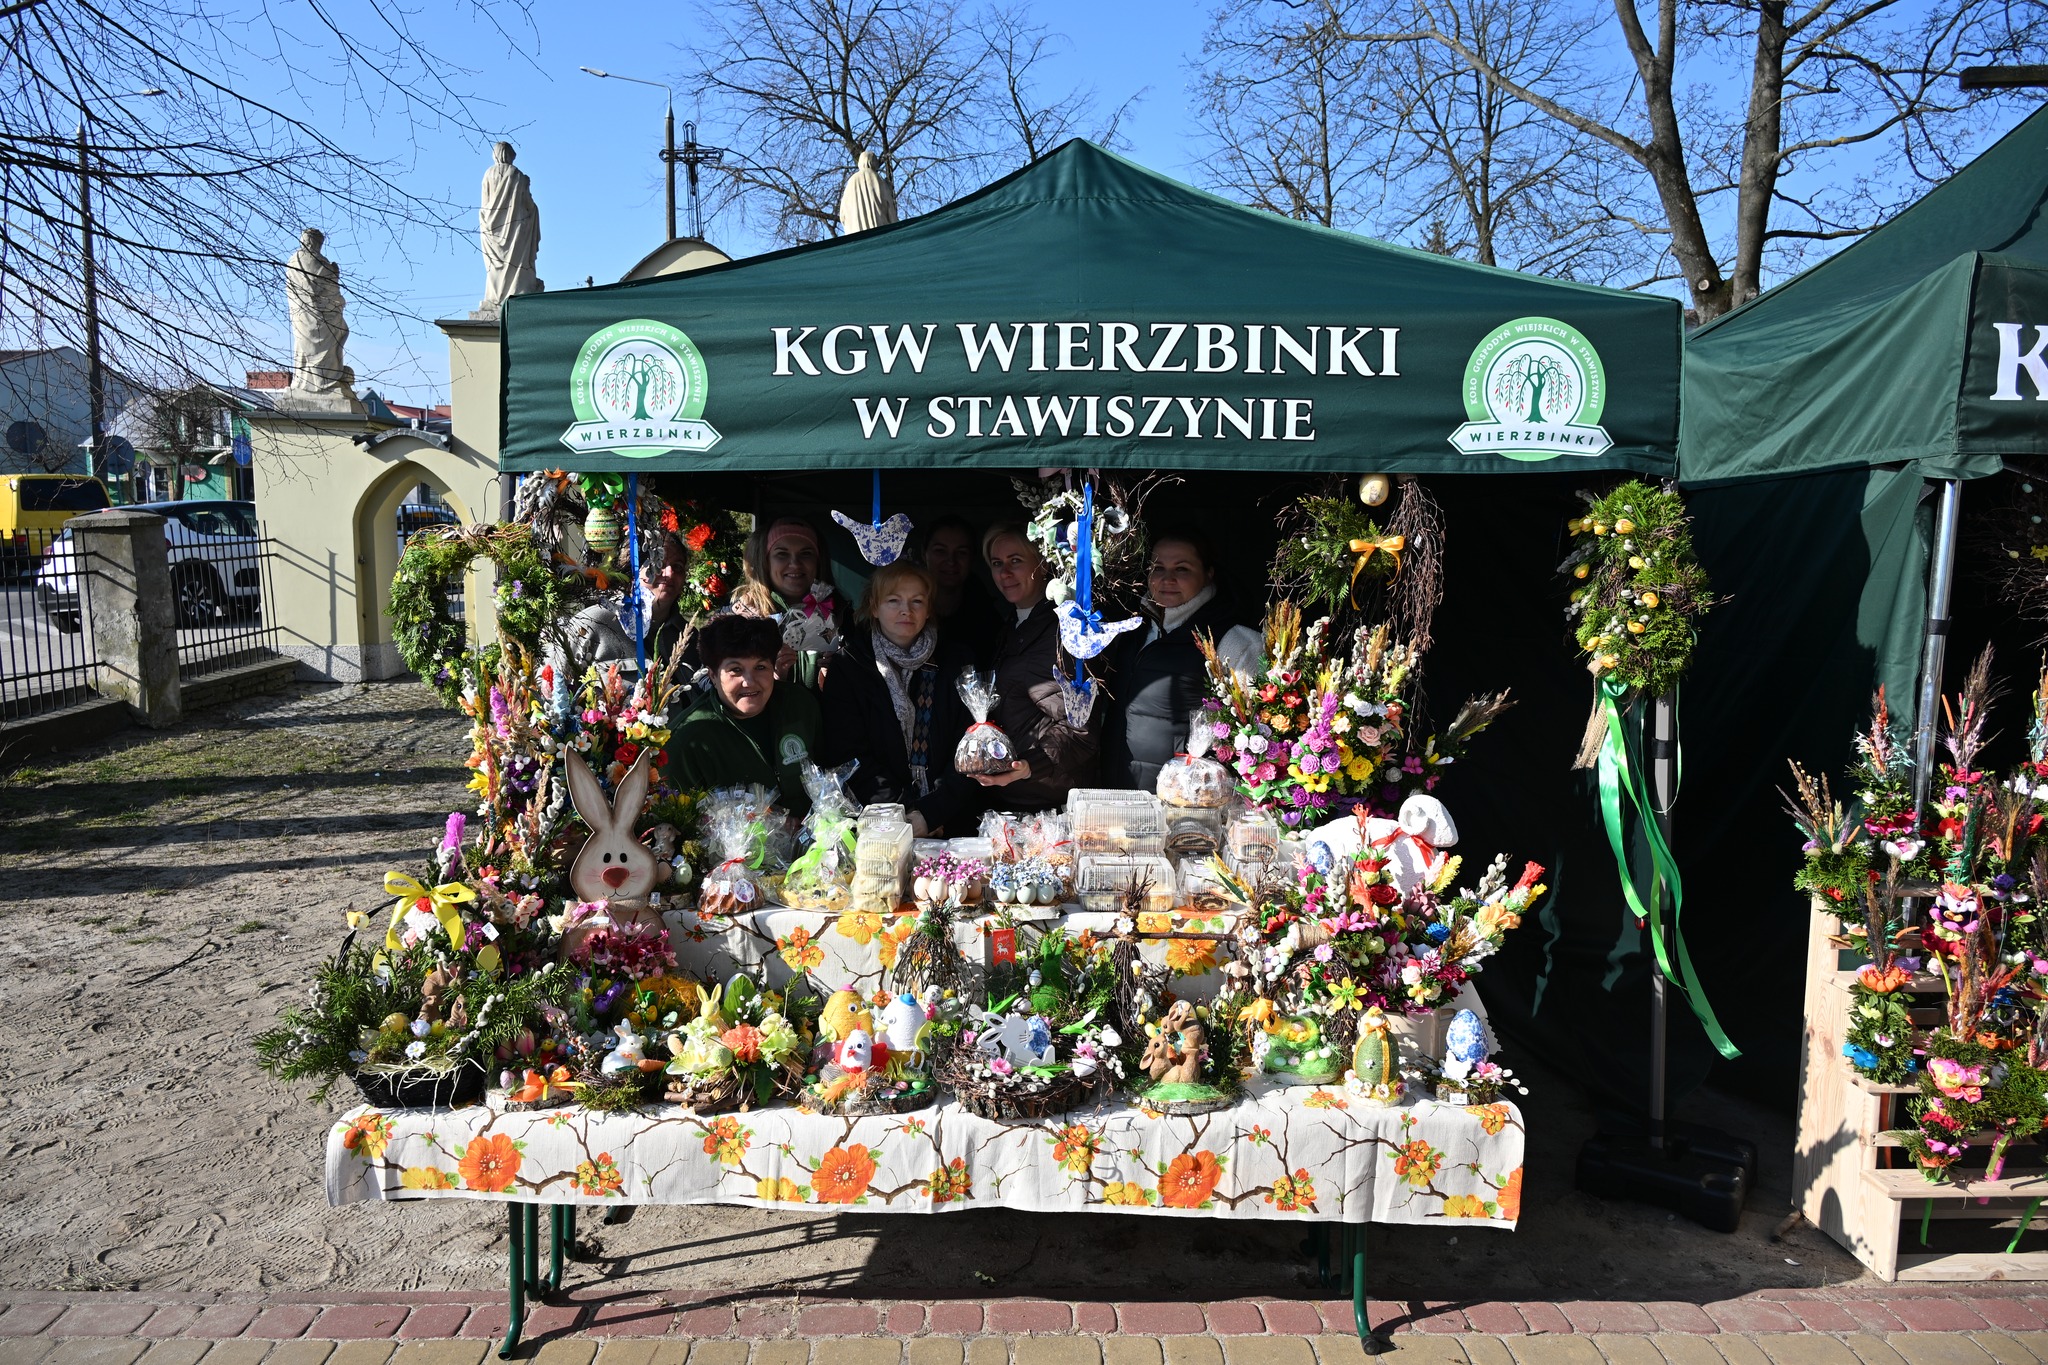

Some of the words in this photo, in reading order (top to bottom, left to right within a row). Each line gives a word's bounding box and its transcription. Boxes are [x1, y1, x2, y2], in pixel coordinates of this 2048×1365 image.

[576, 378, 586, 406] KOŁO
[617, 325, 668, 337] WIEJSKICH
[670, 333, 680, 343] W
[679, 343, 702, 403] STAWISZYNIE
[771, 325, 938, 376] KGW
[956, 323, 1400, 377] WIERZBINKI
[1469, 377, 1478, 405] KOŁO
[1514, 323, 1568, 339] WIEJSKICH
[1569, 335, 1580, 346] W
[1578, 346, 1600, 409] STAWISZYNIE
[580, 428, 701, 442] WIERZBINKI
[853, 397, 910, 440] W
[928, 395, 1315, 441] STAWISZYNIE
[1469, 430, 1594, 446] WIERZBINKI
